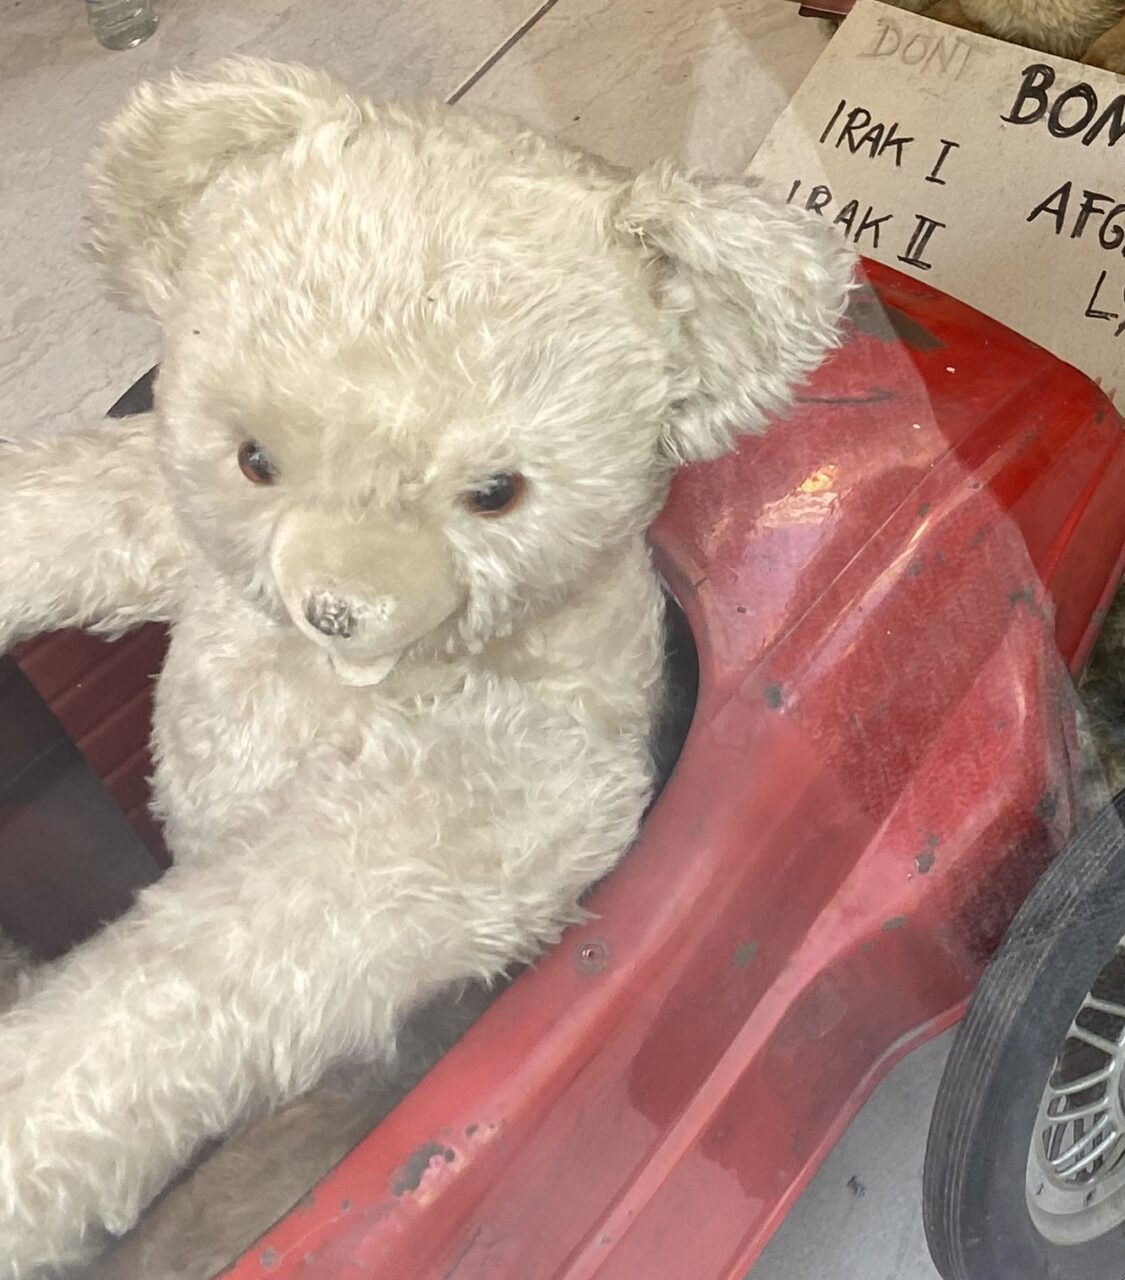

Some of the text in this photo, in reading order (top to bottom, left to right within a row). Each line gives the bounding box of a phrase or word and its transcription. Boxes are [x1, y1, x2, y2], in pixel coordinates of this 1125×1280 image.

[819, 99, 960, 185] IRAK I
[786, 179, 947, 271] IRAK II
